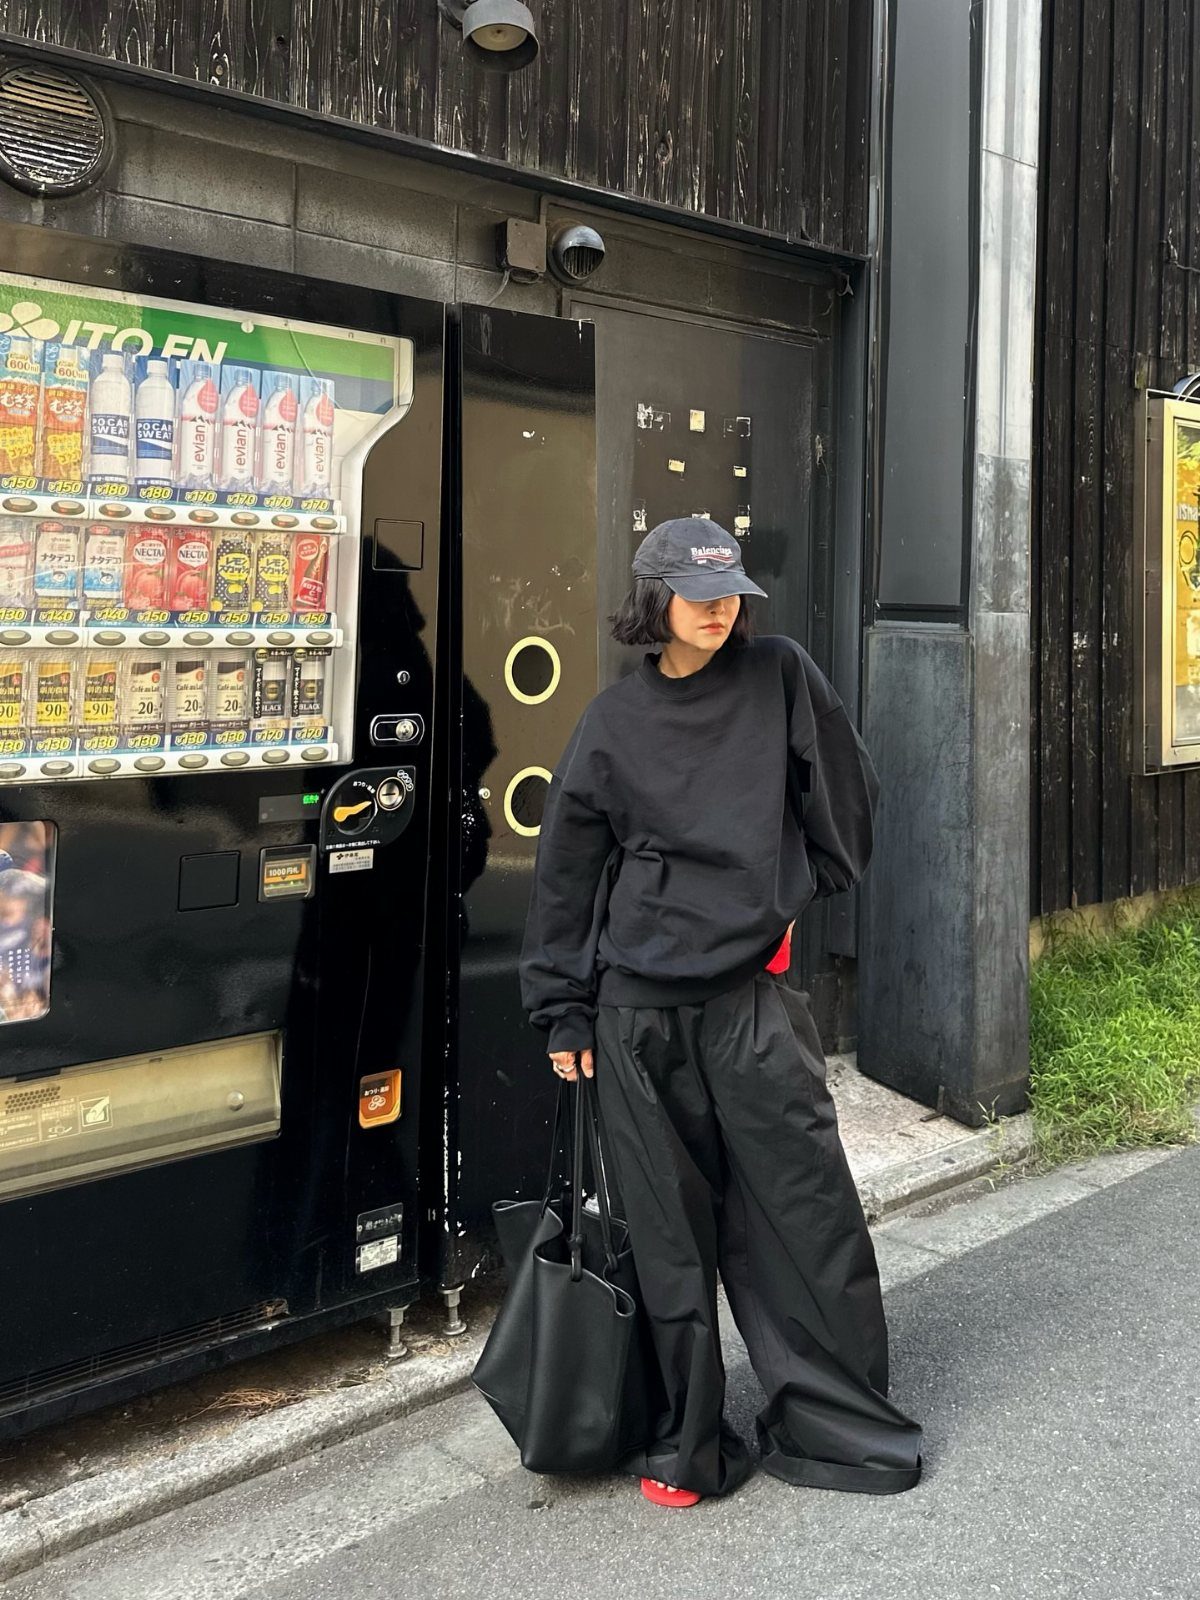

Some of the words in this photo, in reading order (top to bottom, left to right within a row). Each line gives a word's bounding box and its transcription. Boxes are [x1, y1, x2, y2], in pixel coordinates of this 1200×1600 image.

[61, 319, 154, 363] ITO
[92, 426, 128, 436] SWEAT
[193, 424, 206, 463] evian
[235, 427, 247, 466] evian
[275, 432, 287, 470] evian
[314, 437, 324, 473] evian
[45, 703, 62, 717] 90
[92, 703, 109, 716] 90
[138, 701, 154, 715] 20
[184, 699, 199, 712] 20
[224, 699, 239, 712] 20
[299, 703, 320, 711] BLACK
